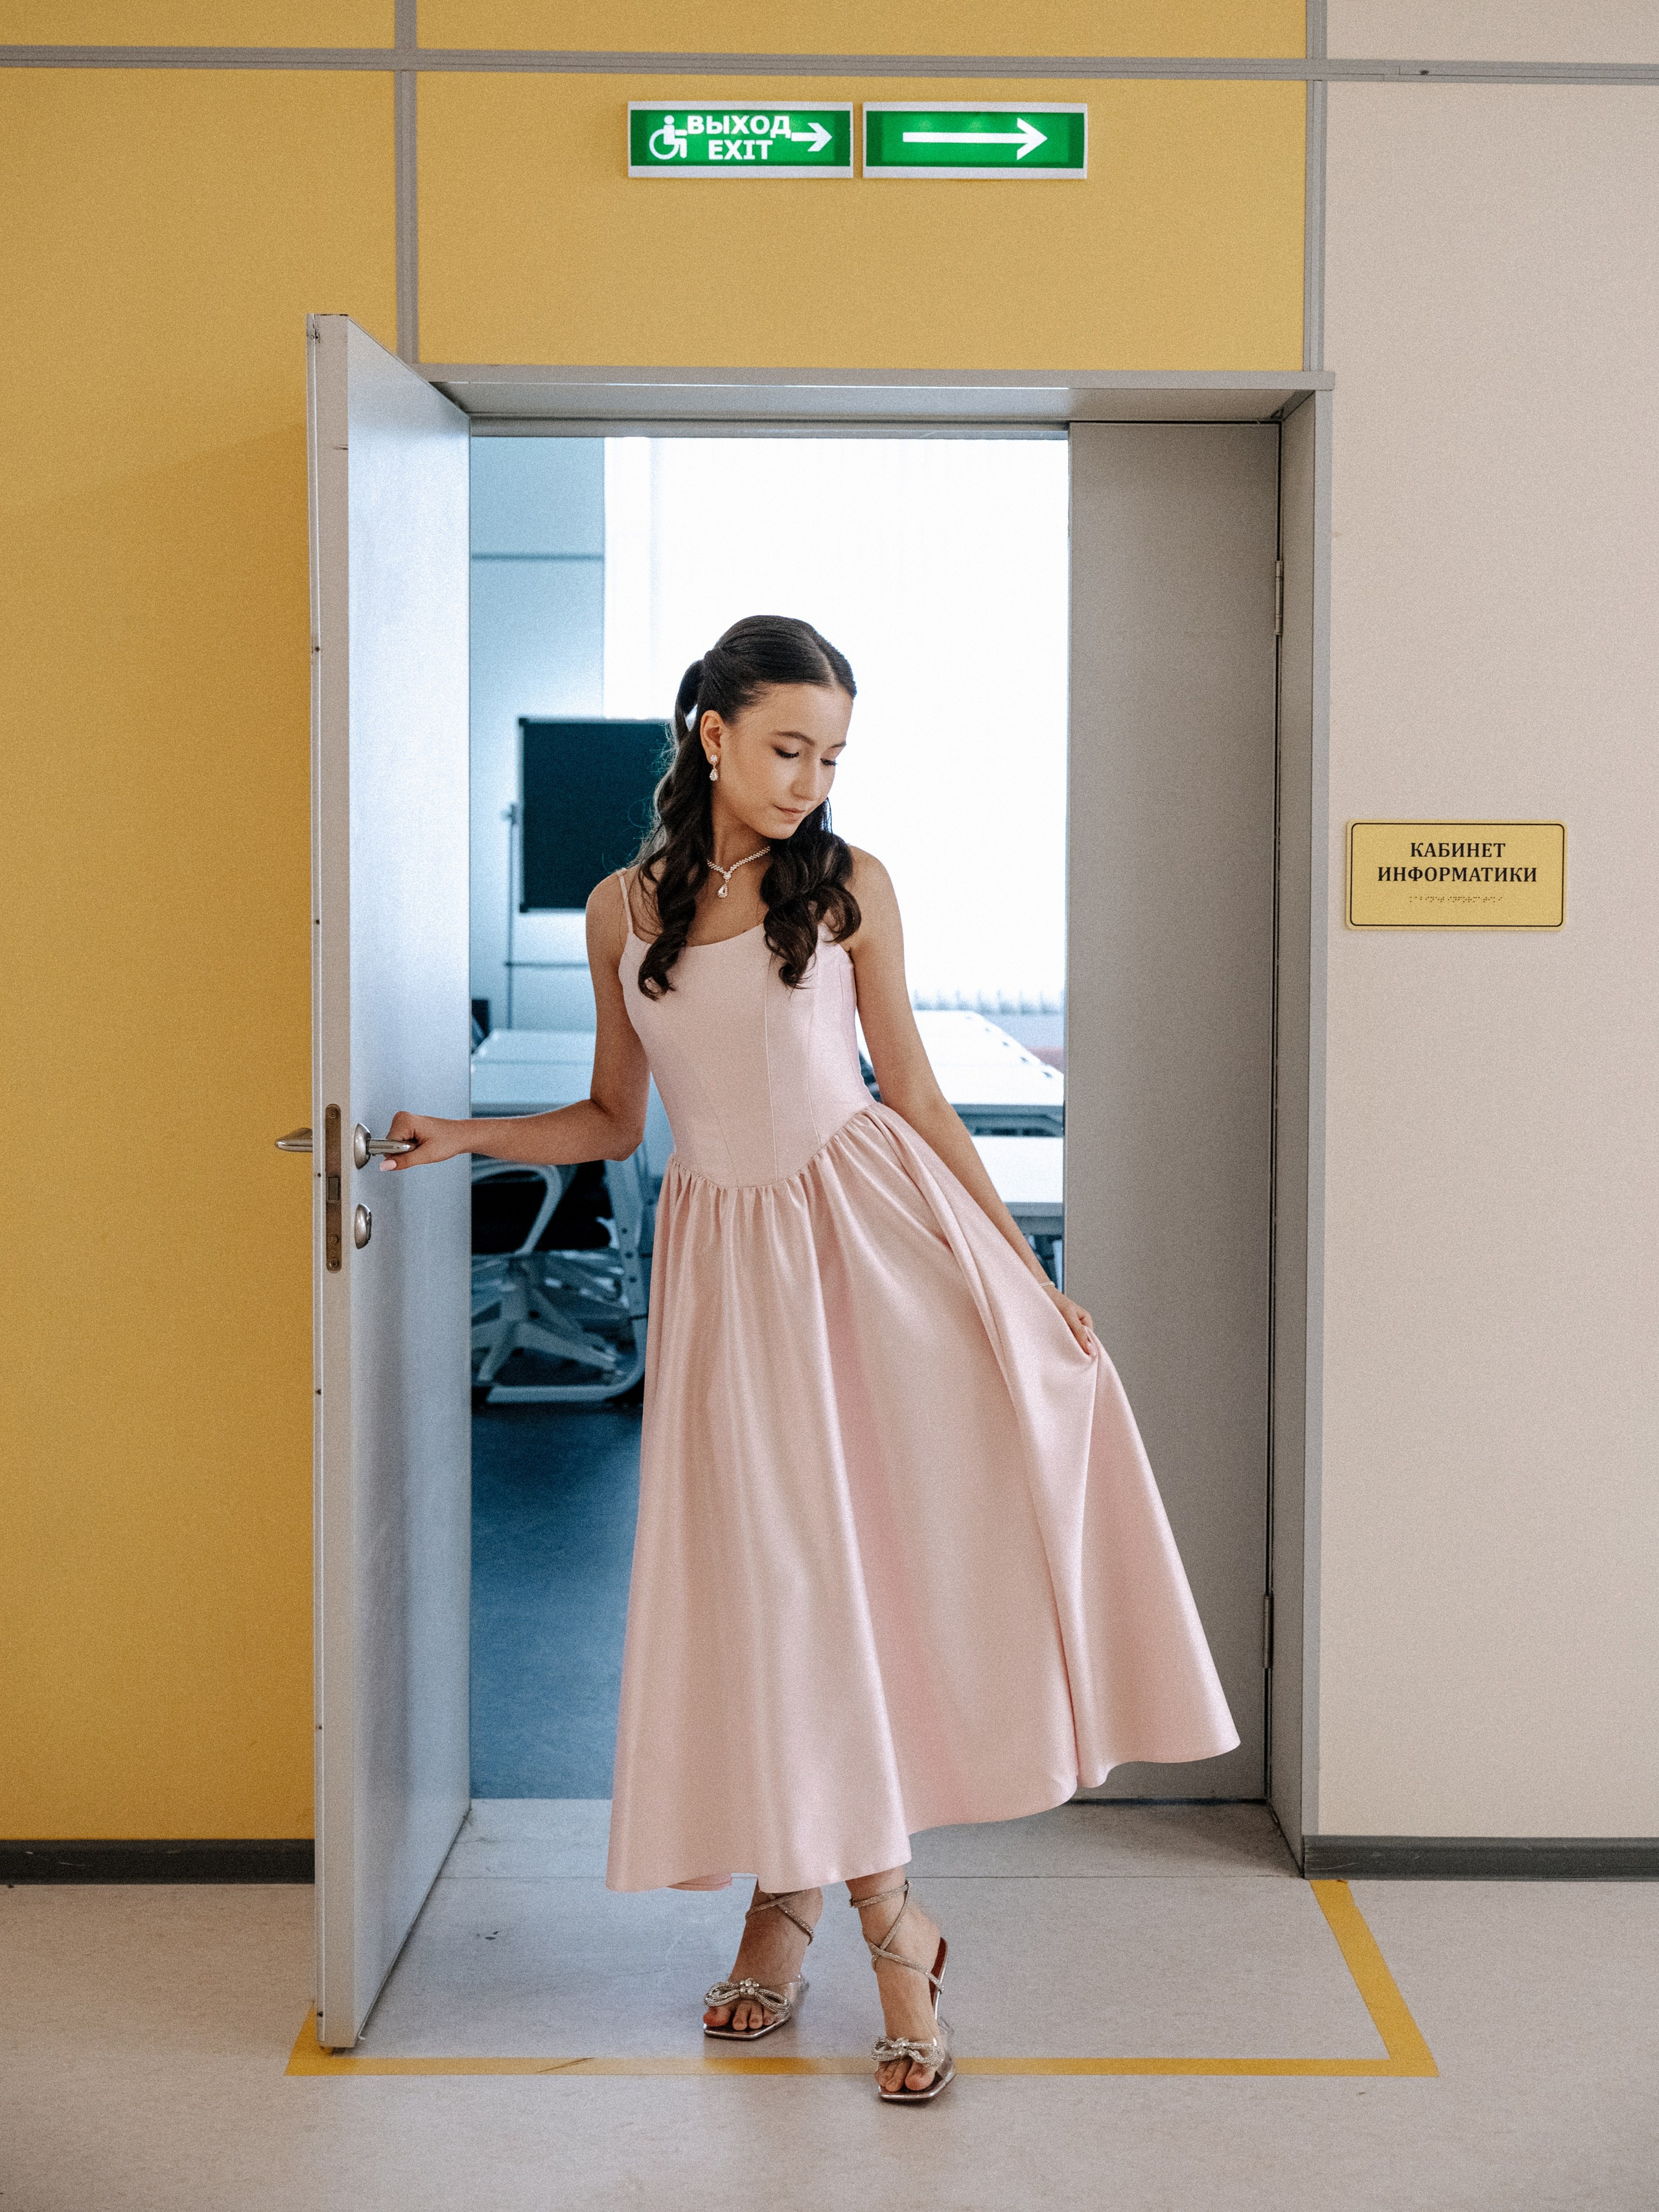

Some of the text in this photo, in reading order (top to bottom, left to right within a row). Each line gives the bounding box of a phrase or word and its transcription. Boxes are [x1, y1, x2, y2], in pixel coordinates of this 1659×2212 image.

[687, 115, 791, 139] ВЫХОД
[708, 139, 772, 160] EXIT
[1410, 843, 1505, 857] КАБИНЕТ
[1378, 867, 1537, 882] ИНФОРМАТИКИ
